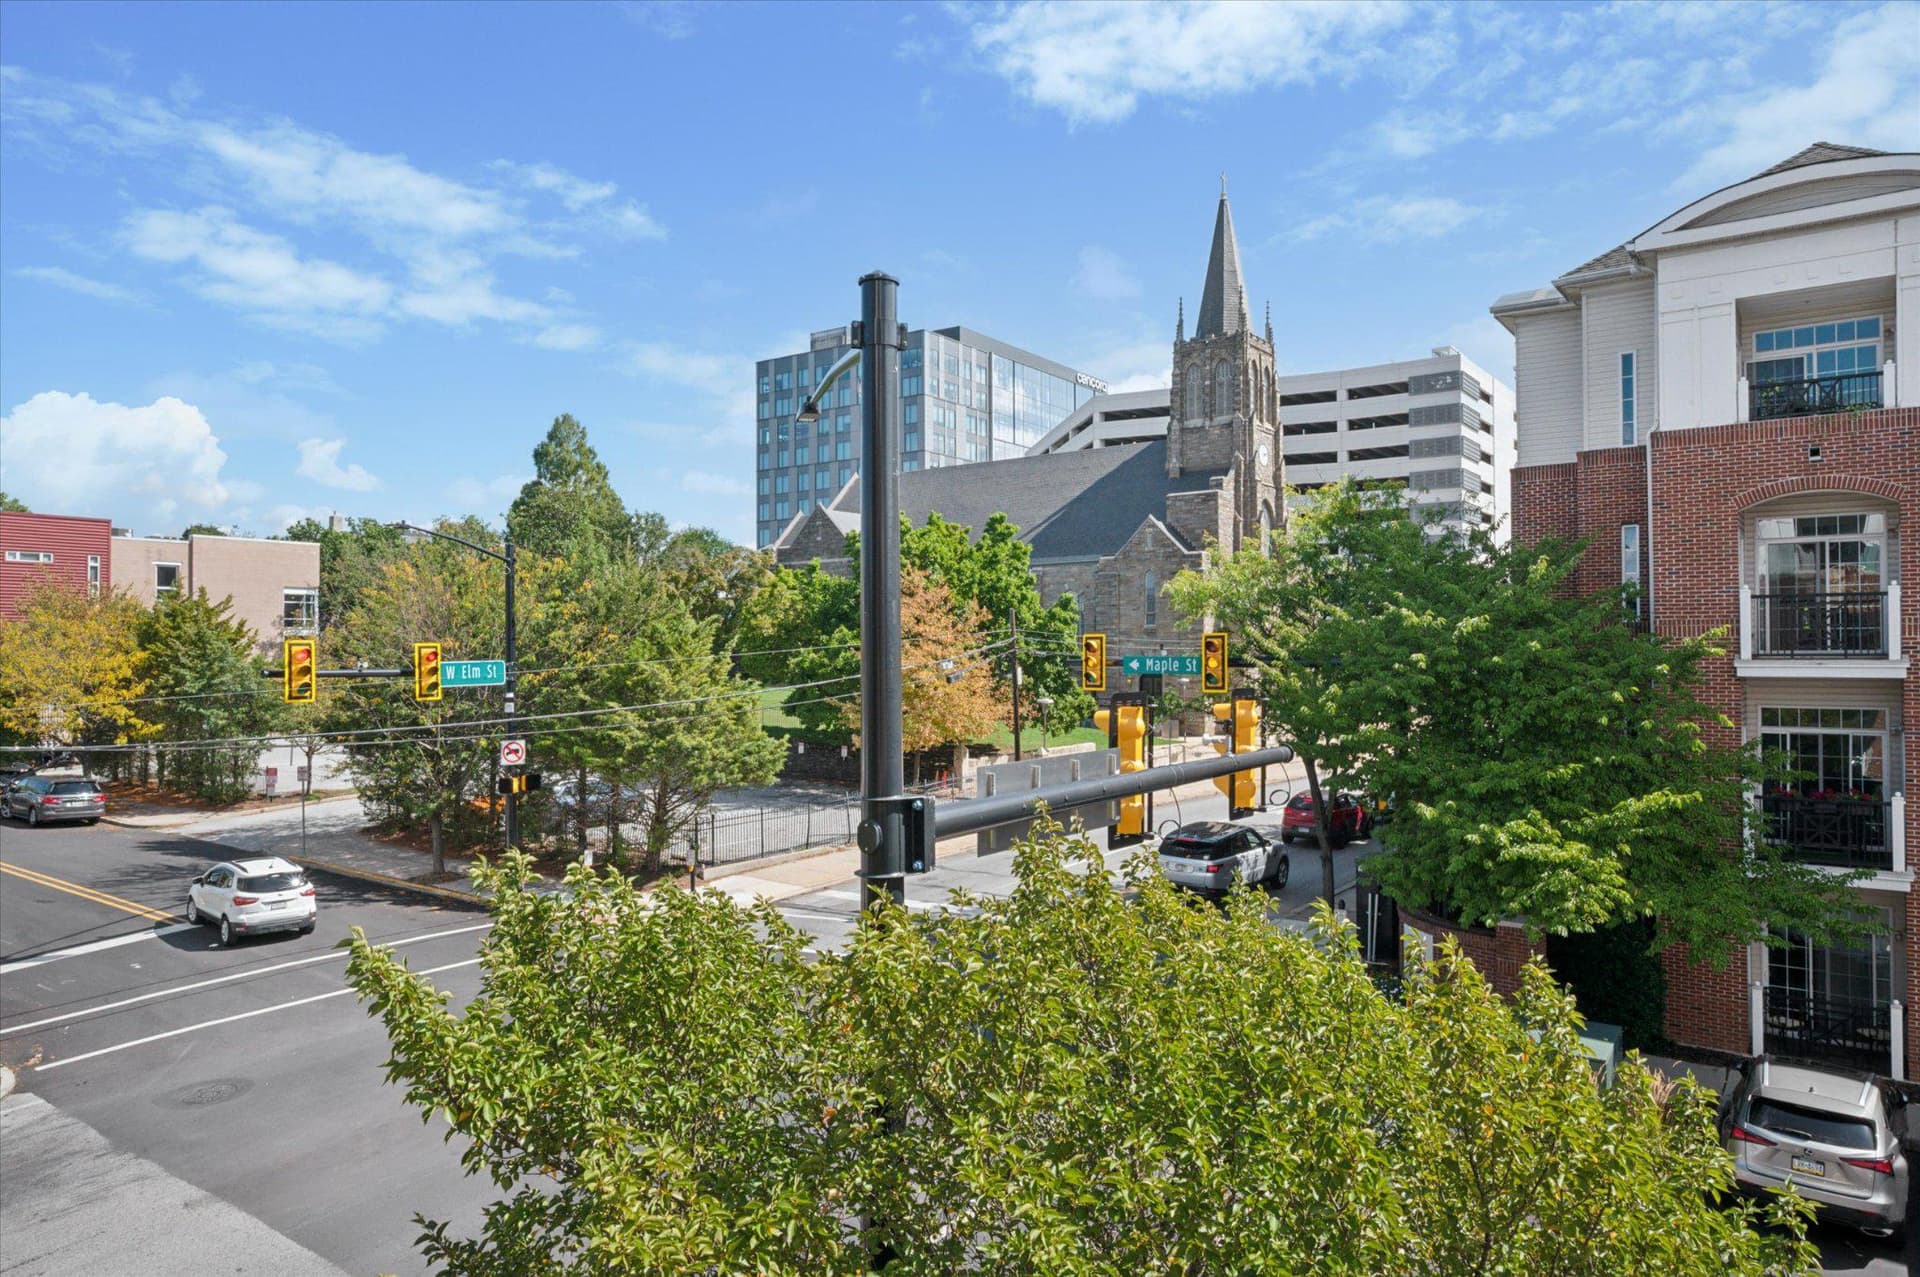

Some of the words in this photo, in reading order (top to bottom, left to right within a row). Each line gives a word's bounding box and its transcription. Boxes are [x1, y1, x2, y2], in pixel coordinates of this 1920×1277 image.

[446, 665, 455, 680] W
[462, 664, 481, 679] Elm
[487, 664, 497, 678] St
[1146, 657, 1179, 673] Maple
[1186, 658, 1197, 672] St
